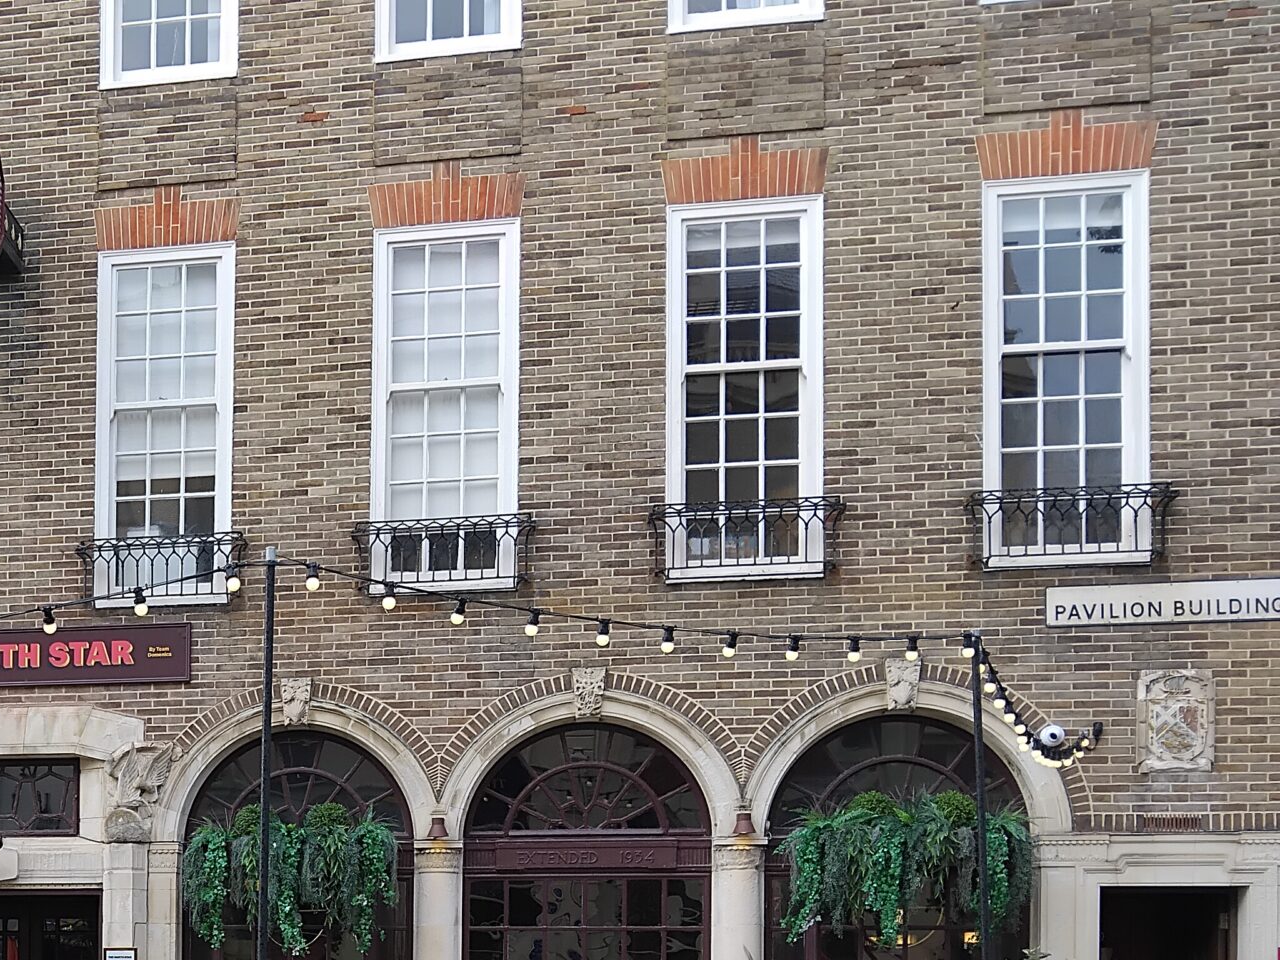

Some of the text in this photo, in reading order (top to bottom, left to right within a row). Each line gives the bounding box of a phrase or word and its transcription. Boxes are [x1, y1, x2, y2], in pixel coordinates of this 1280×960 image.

[1055, 601, 1162, 621] PAVILION
[48, 640, 135, 668] STAR
[516, 849, 656, 865] EXTENDED 1934
